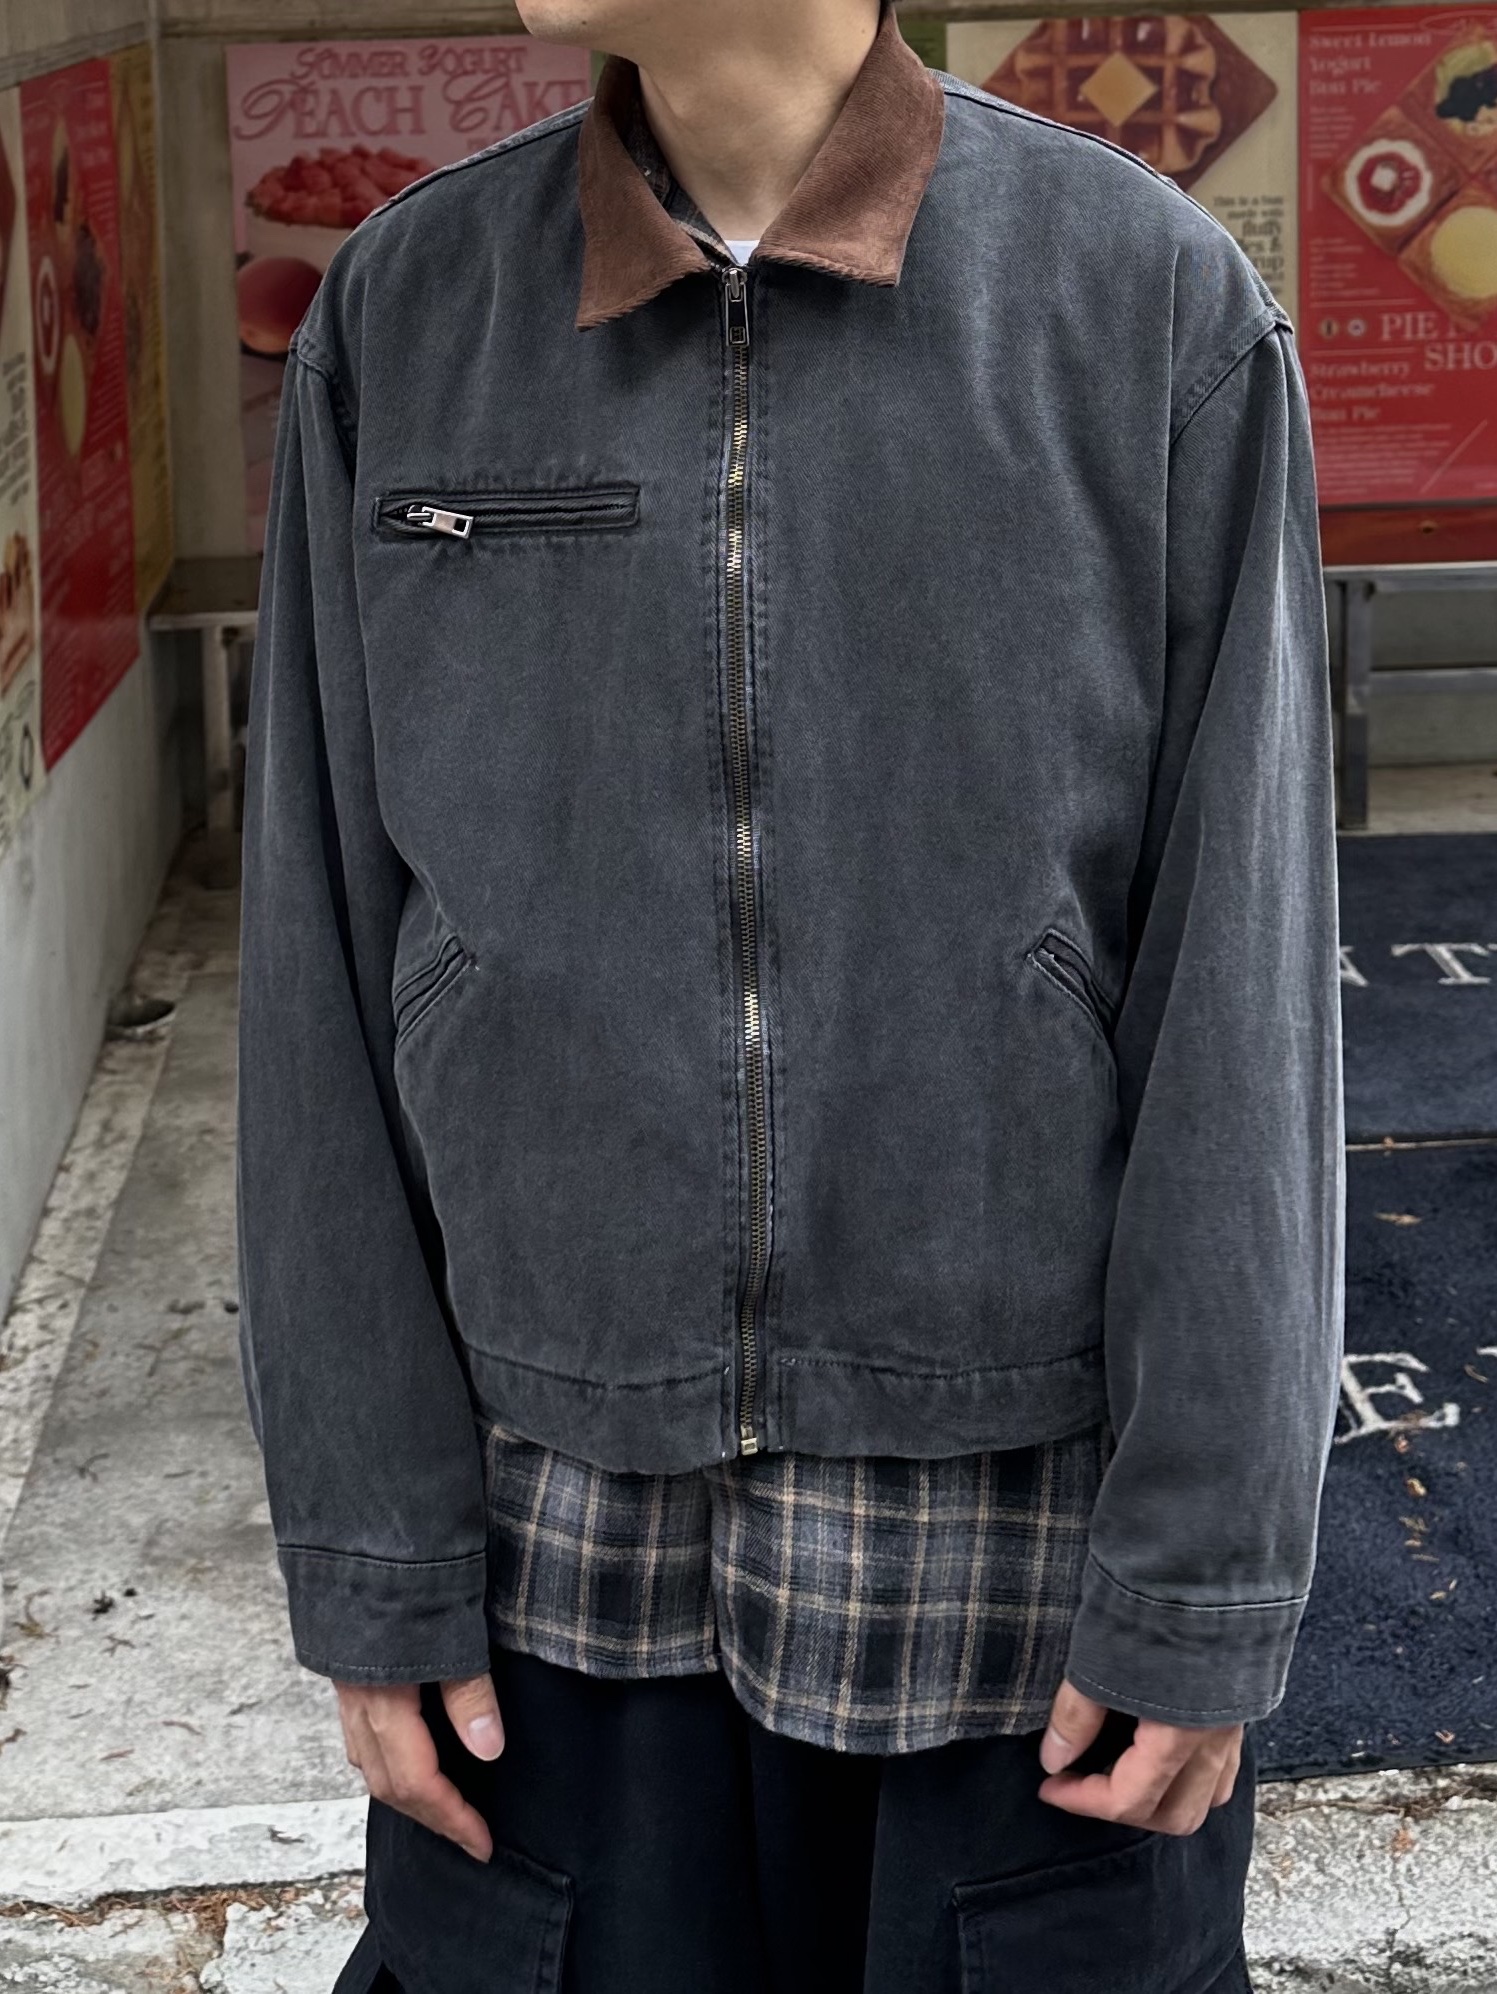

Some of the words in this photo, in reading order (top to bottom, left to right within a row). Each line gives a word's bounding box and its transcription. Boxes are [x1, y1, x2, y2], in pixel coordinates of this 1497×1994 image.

[233, 78, 427, 140] PEACH
[1378, 311, 1439, 341] PIE
[1424, 340, 1497, 371] SHO
